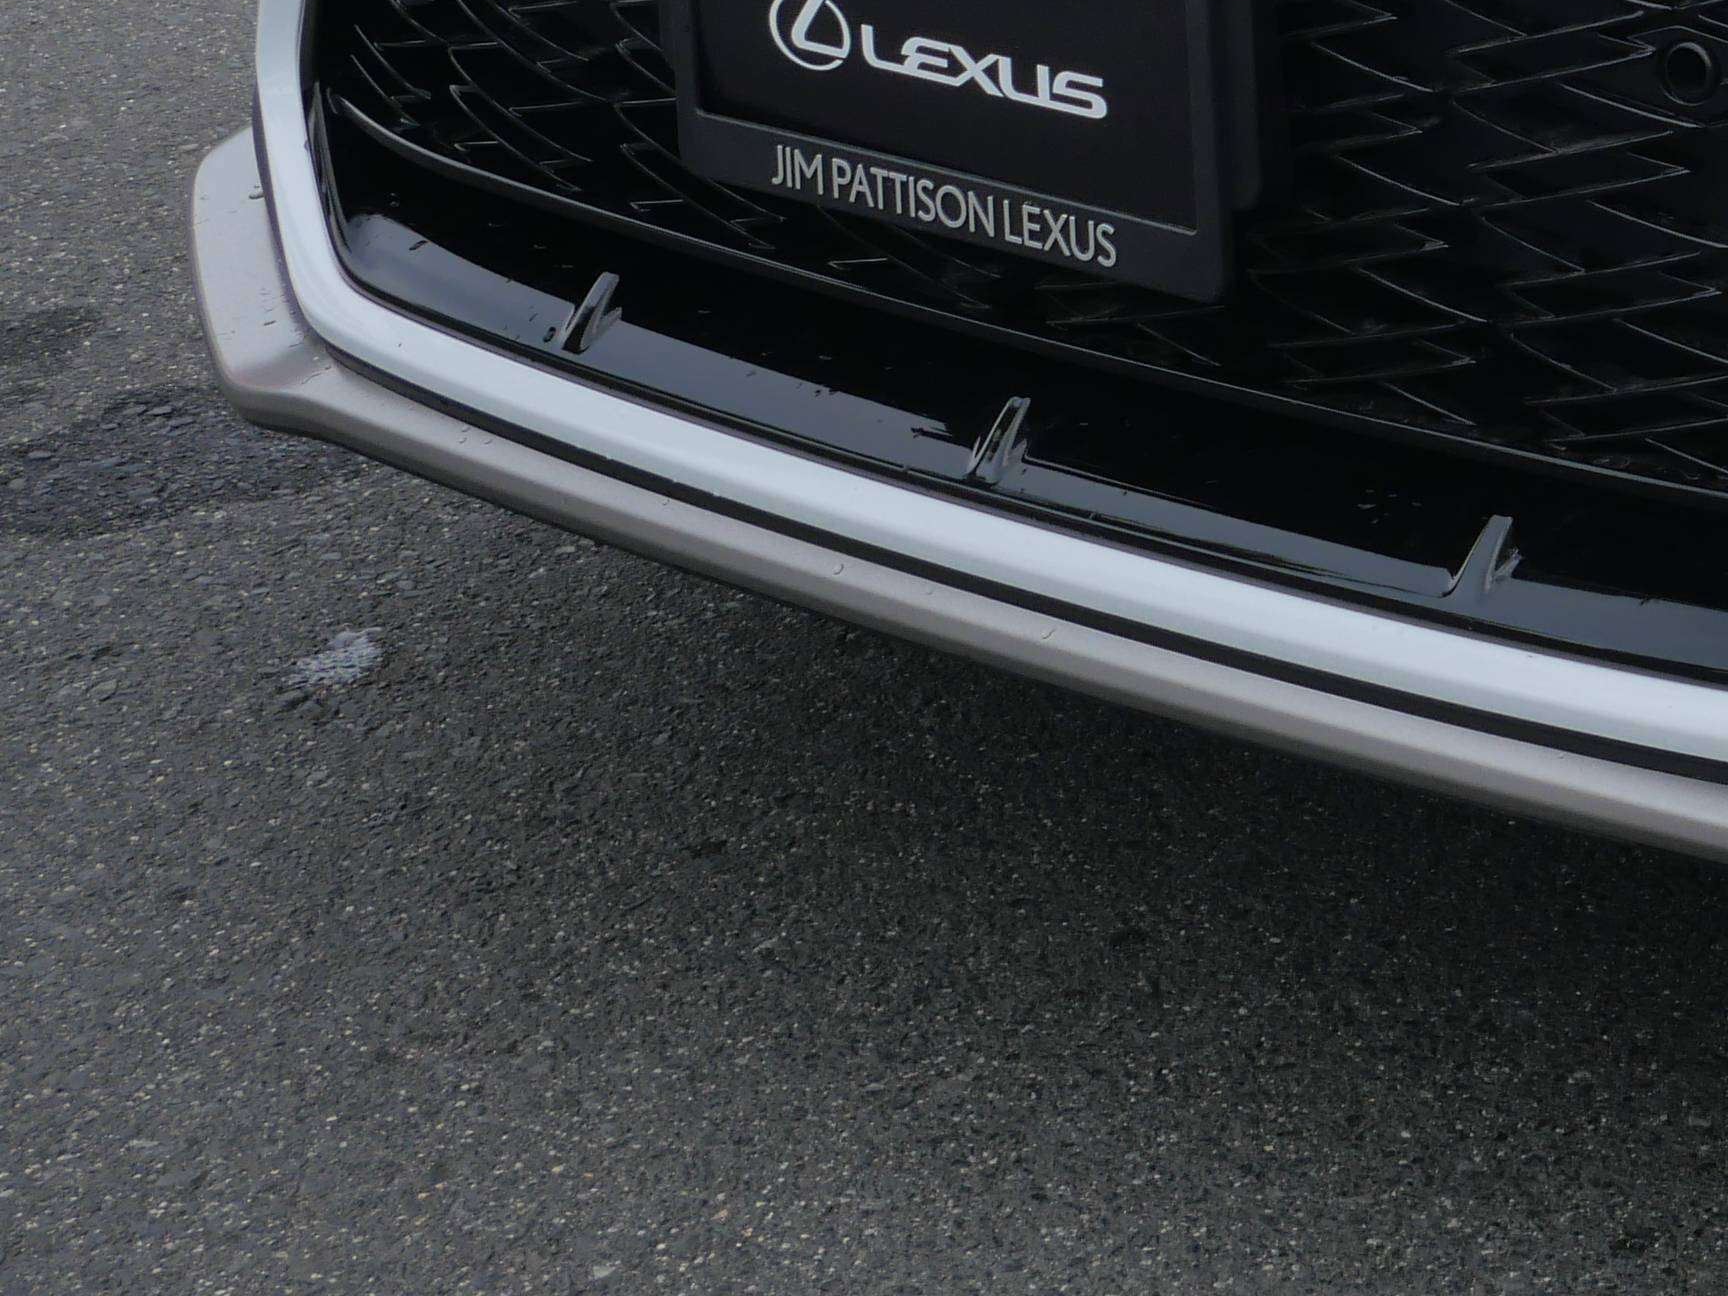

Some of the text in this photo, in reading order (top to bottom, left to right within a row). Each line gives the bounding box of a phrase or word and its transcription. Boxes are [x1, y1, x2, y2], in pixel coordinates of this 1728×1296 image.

[860, 23, 1108, 120] LEXUS
[771, 144, 1118, 269] JIM PATTISON LEXUS
